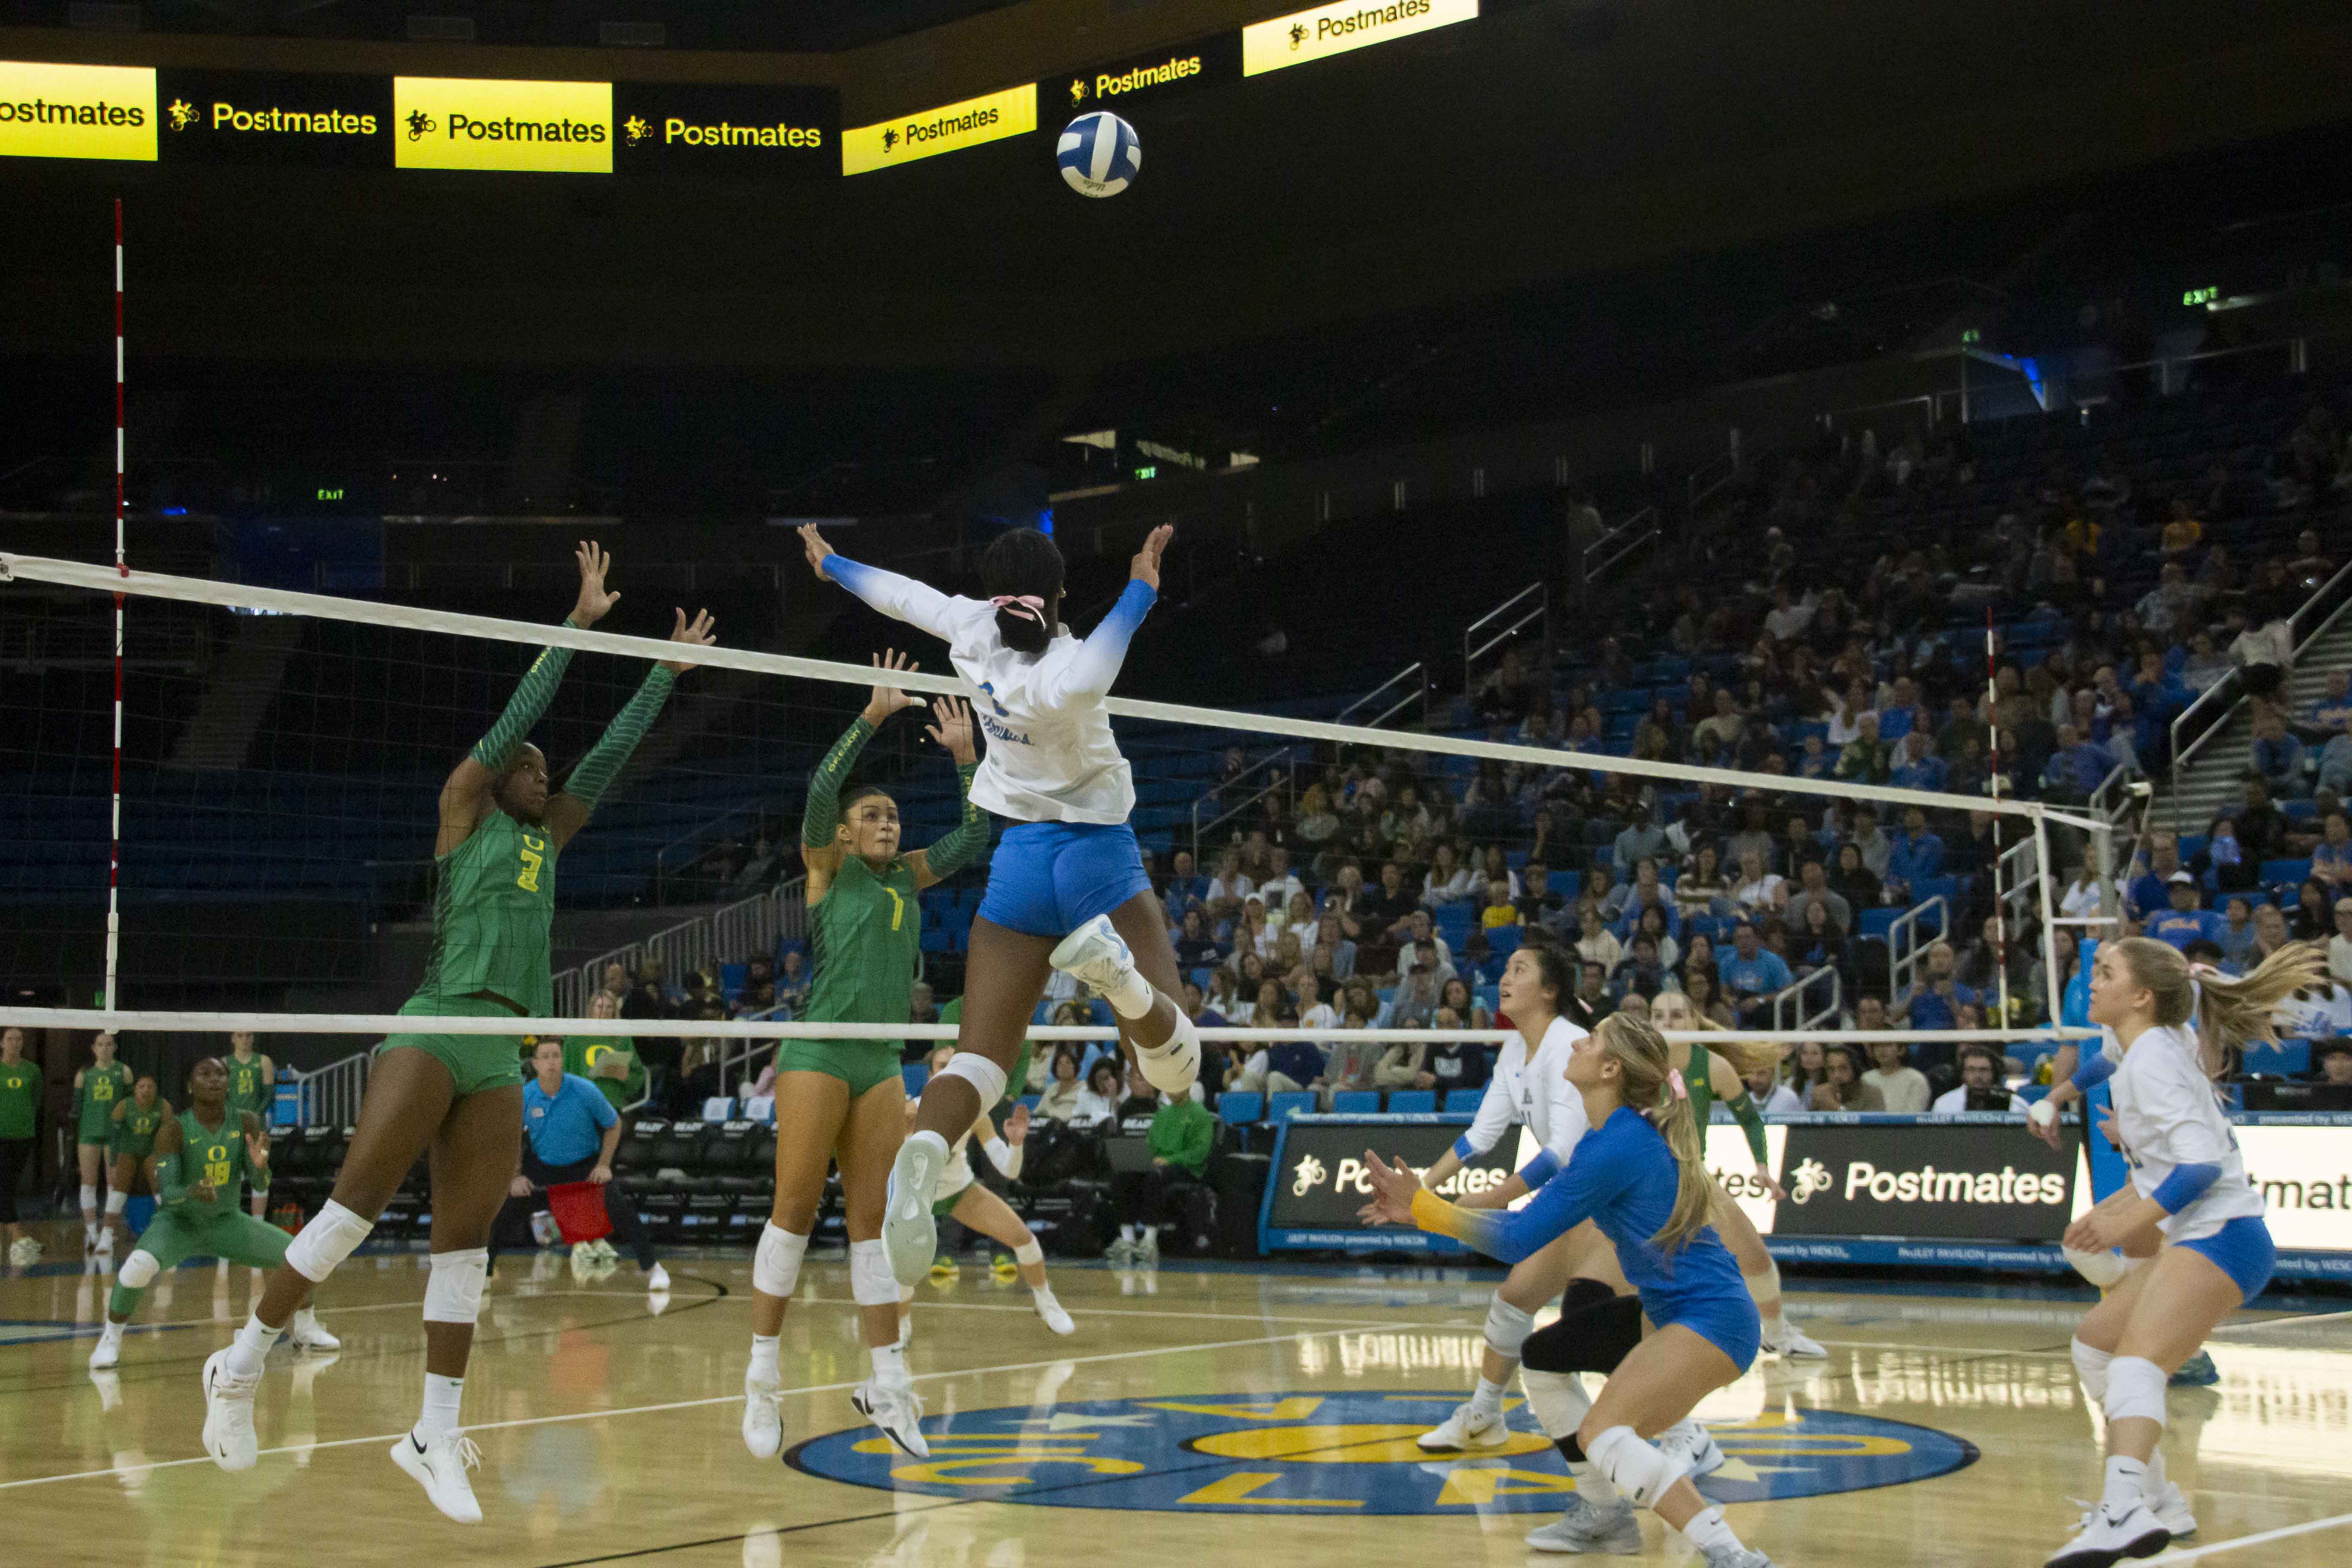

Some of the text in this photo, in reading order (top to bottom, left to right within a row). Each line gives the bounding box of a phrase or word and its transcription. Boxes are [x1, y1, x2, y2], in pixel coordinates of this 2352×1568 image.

[1317, 0, 1431, 41] Postmates
[1096, 57, 1201, 99] Postmates
[213, 102, 377, 135] Postmates
[449, 113, 606, 144] Postmates
[665, 118, 821, 148] Postmates
[905, 106, 999, 145] Postmates
[2183, 286, 2218, 305] EXIT
[318, 489, 344, 500] EXIT
[1844, 1161, 2065, 1204] Postmates
